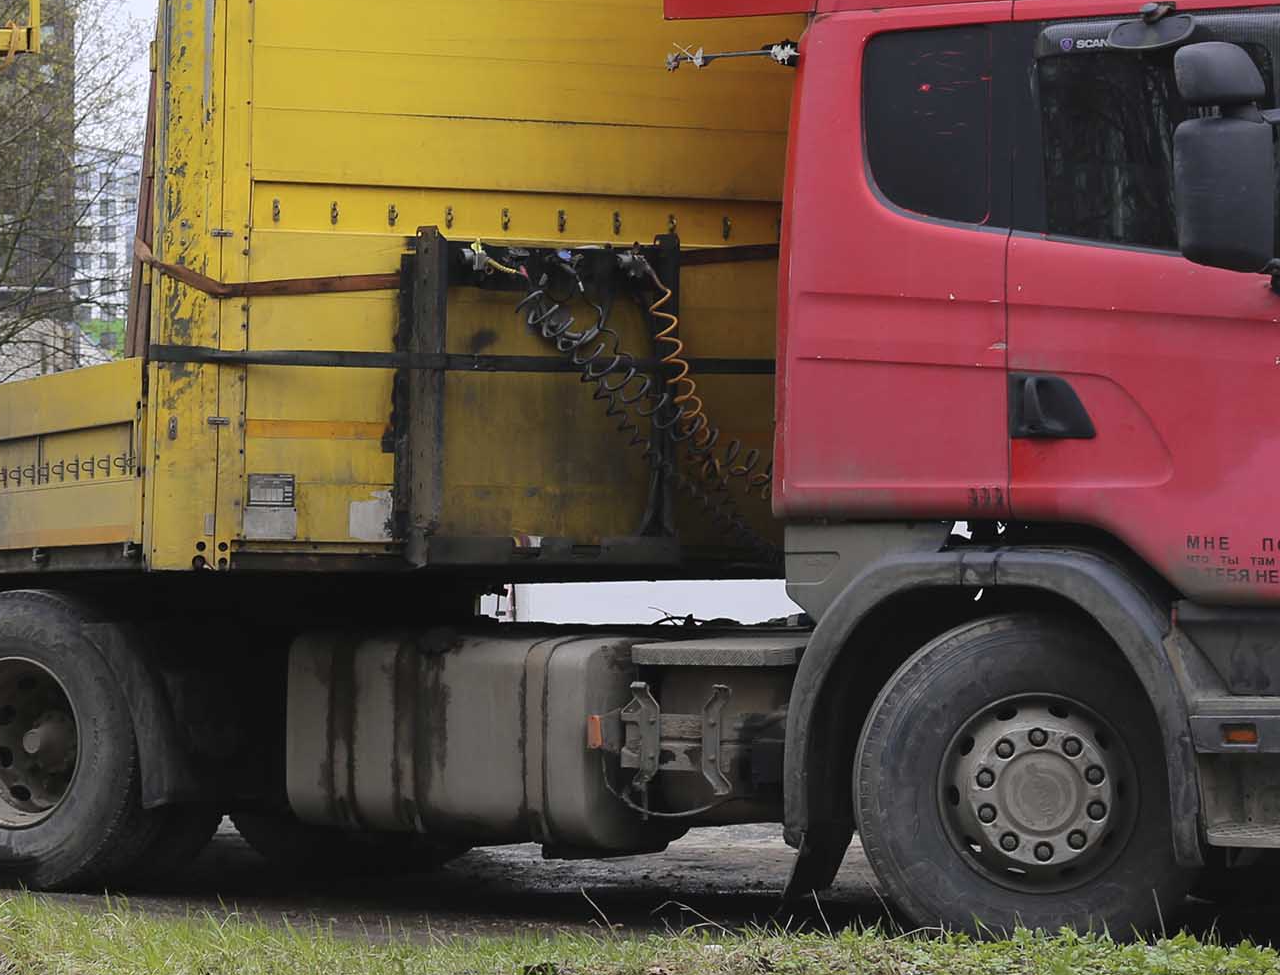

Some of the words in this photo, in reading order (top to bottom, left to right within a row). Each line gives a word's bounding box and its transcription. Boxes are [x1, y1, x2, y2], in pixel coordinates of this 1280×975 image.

[1186, 535, 1230, 551] МНЕ
[1262, 537, 1280, 552] П
[1248, 556, 1276, 566] там
